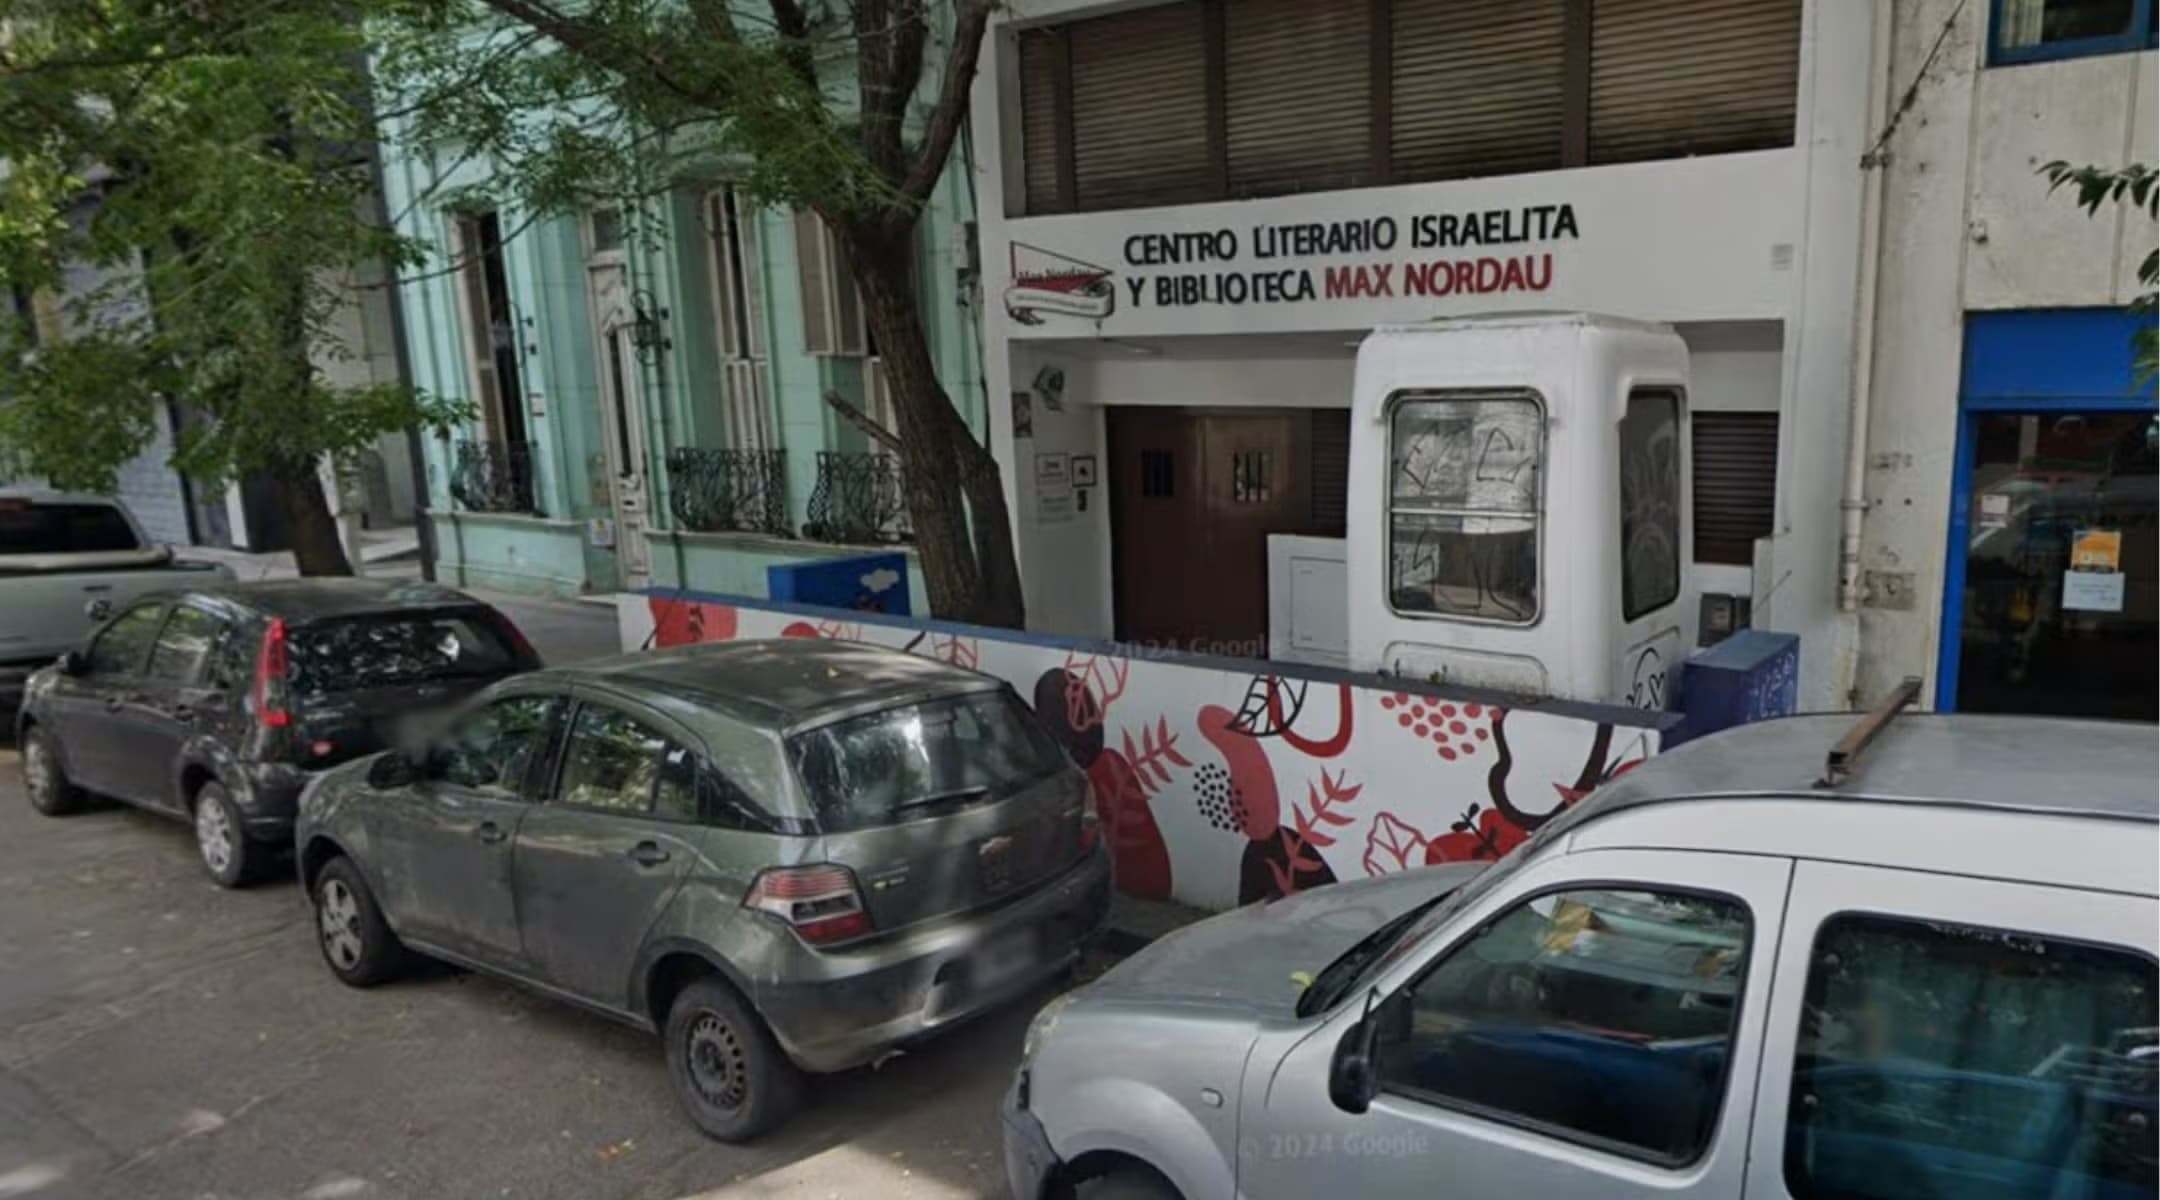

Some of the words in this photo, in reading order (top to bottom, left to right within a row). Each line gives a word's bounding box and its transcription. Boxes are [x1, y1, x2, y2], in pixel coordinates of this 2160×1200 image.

[1123, 228, 1237, 265] CENTRO
[1254, 216, 1397, 258] LITERARIO
[1411, 204, 1579, 248] ISRAELITA
[1126, 275, 1146, 306] Y
[1155, 269, 1316, 306] BIBLIOTECA
[1325, 264, 1394, 299] MAX
[1403, 253, 1553, 297] NORDAU
